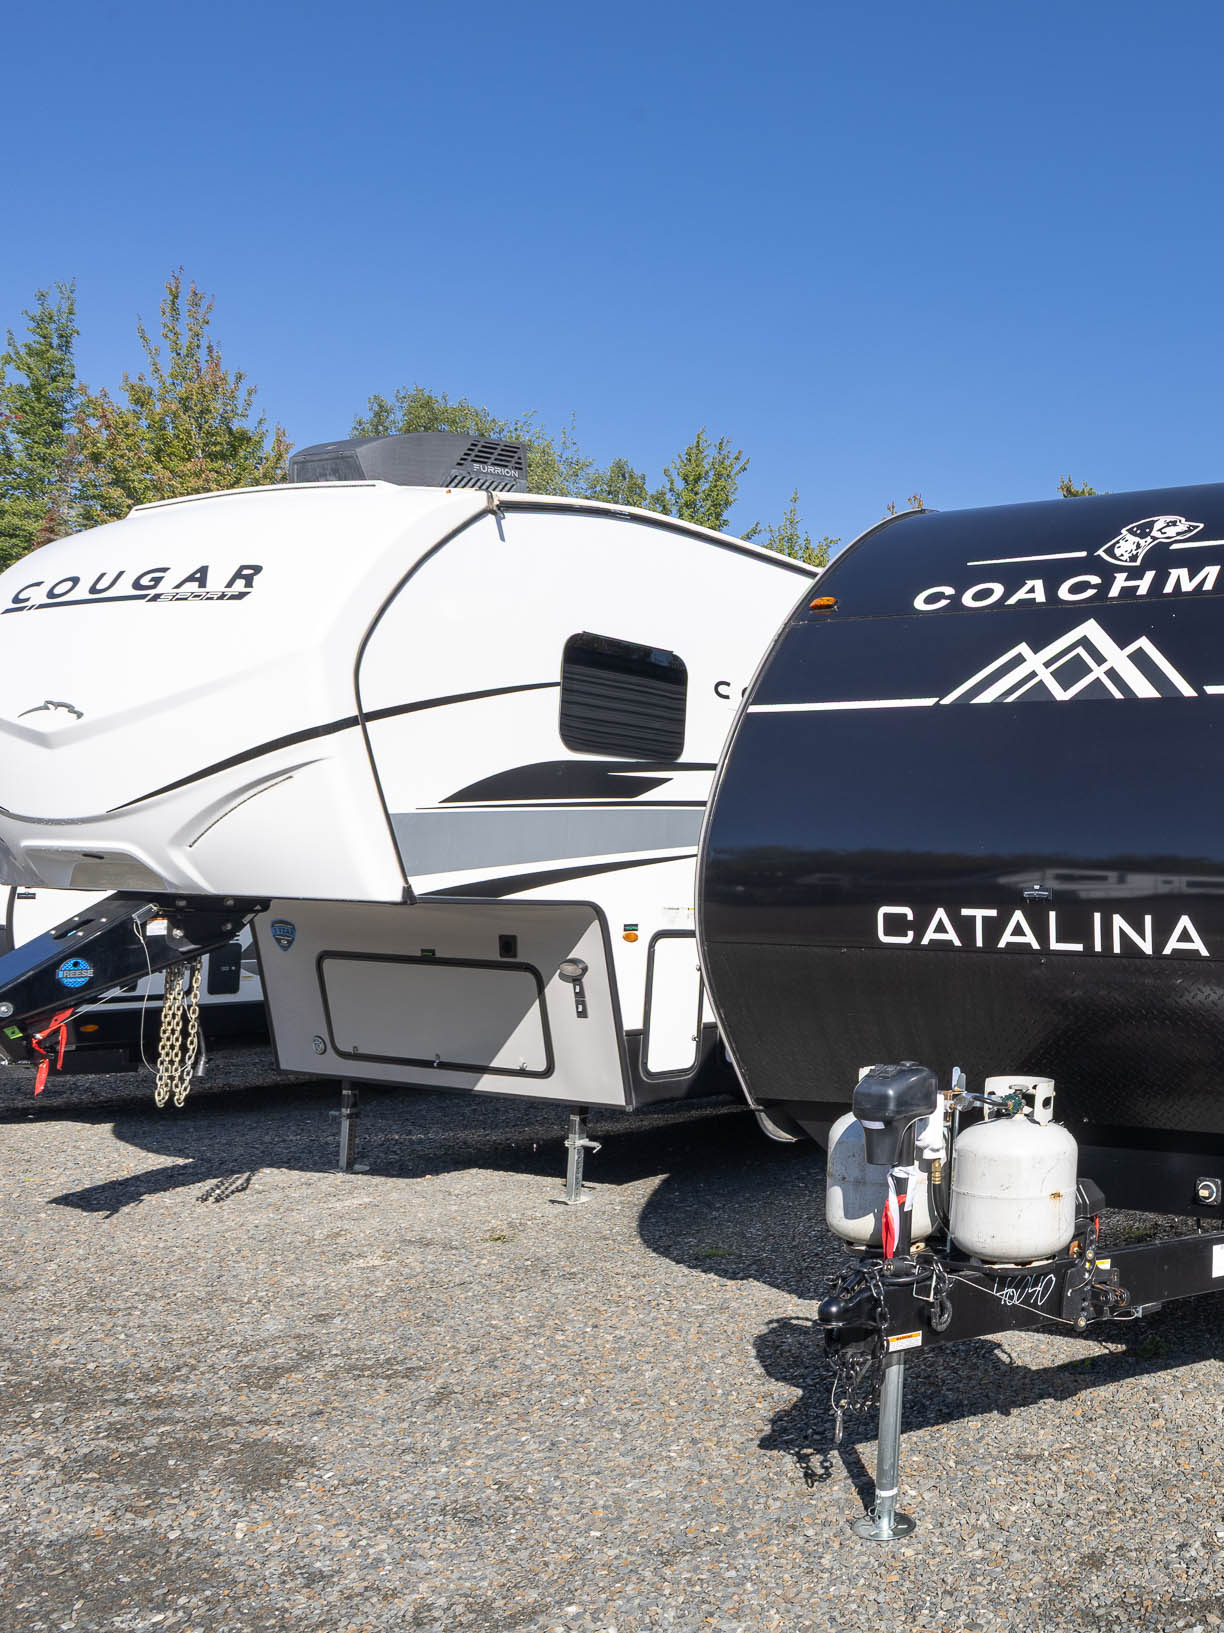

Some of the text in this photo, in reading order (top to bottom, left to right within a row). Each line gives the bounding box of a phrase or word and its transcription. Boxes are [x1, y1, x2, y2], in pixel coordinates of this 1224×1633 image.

[473, 463, 519, 477] FURRION
[11, 564, 263, 604] COUGAR
[157, 591, 240, 602] SPORT
[877, 905, 1210, 957] CATALINA
[64, 969, 94, 978] REESE
